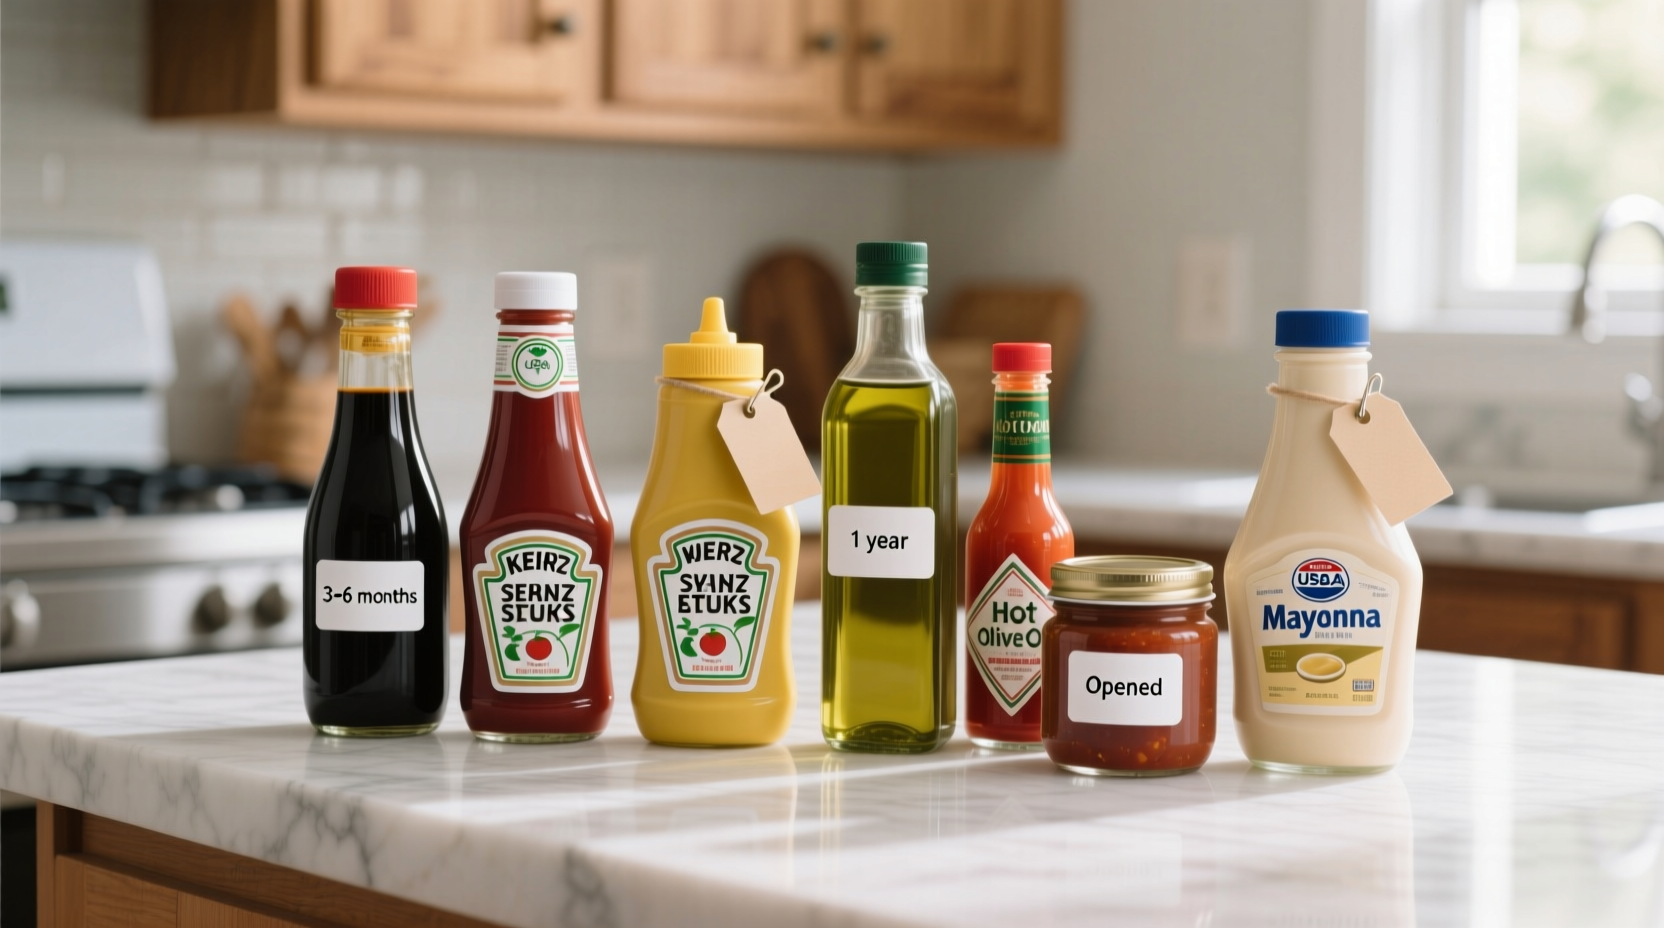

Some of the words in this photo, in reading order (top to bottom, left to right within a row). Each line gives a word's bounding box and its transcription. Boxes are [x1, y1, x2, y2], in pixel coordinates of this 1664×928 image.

[851, 529, 859, 548] 1
[866, 534, 909, 554] year
[322, 585, 353, 604] 3-6
[357, 587, 418, 605] months
[992, 601, 1037, 624] Hot
[1262, 604, 1382, 639] Mayonna
[1085, 675, 1162, 701] Opened
